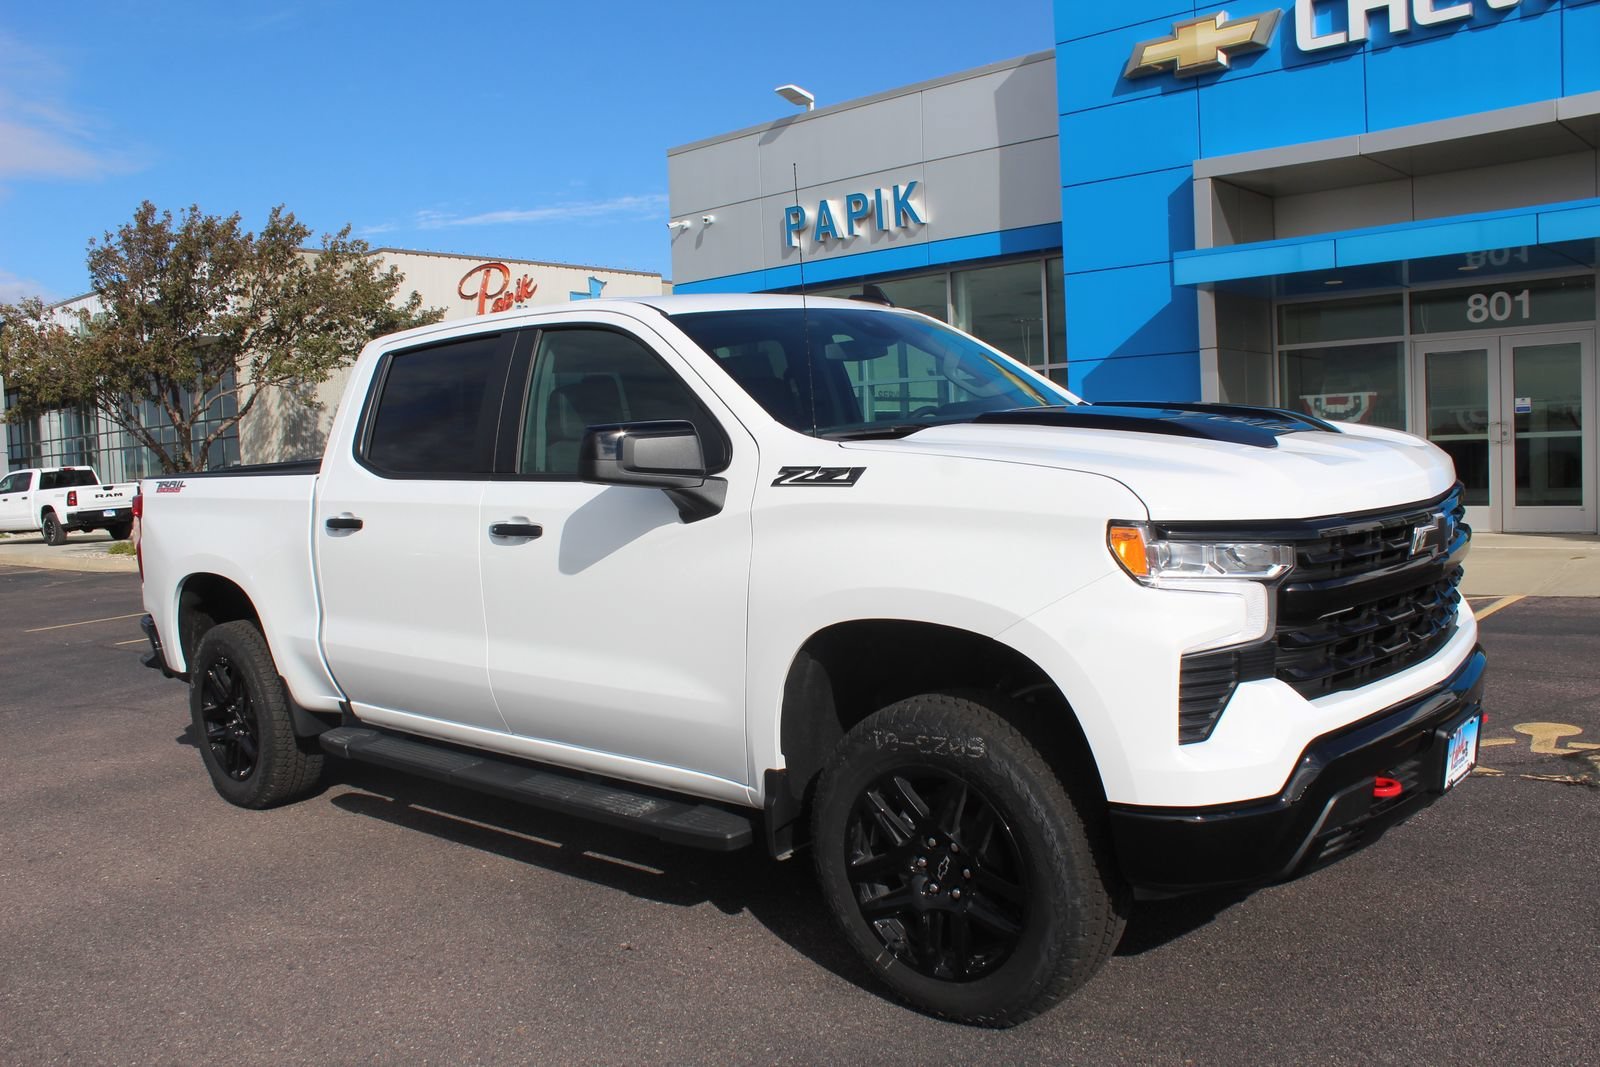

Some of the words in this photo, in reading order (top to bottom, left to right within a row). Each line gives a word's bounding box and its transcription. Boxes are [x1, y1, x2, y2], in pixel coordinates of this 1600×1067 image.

[785, 180, 925, 247] PAPIK
[1466, 289, 1530, 323] 801
[156, 481, 187, 489] TRAIL
